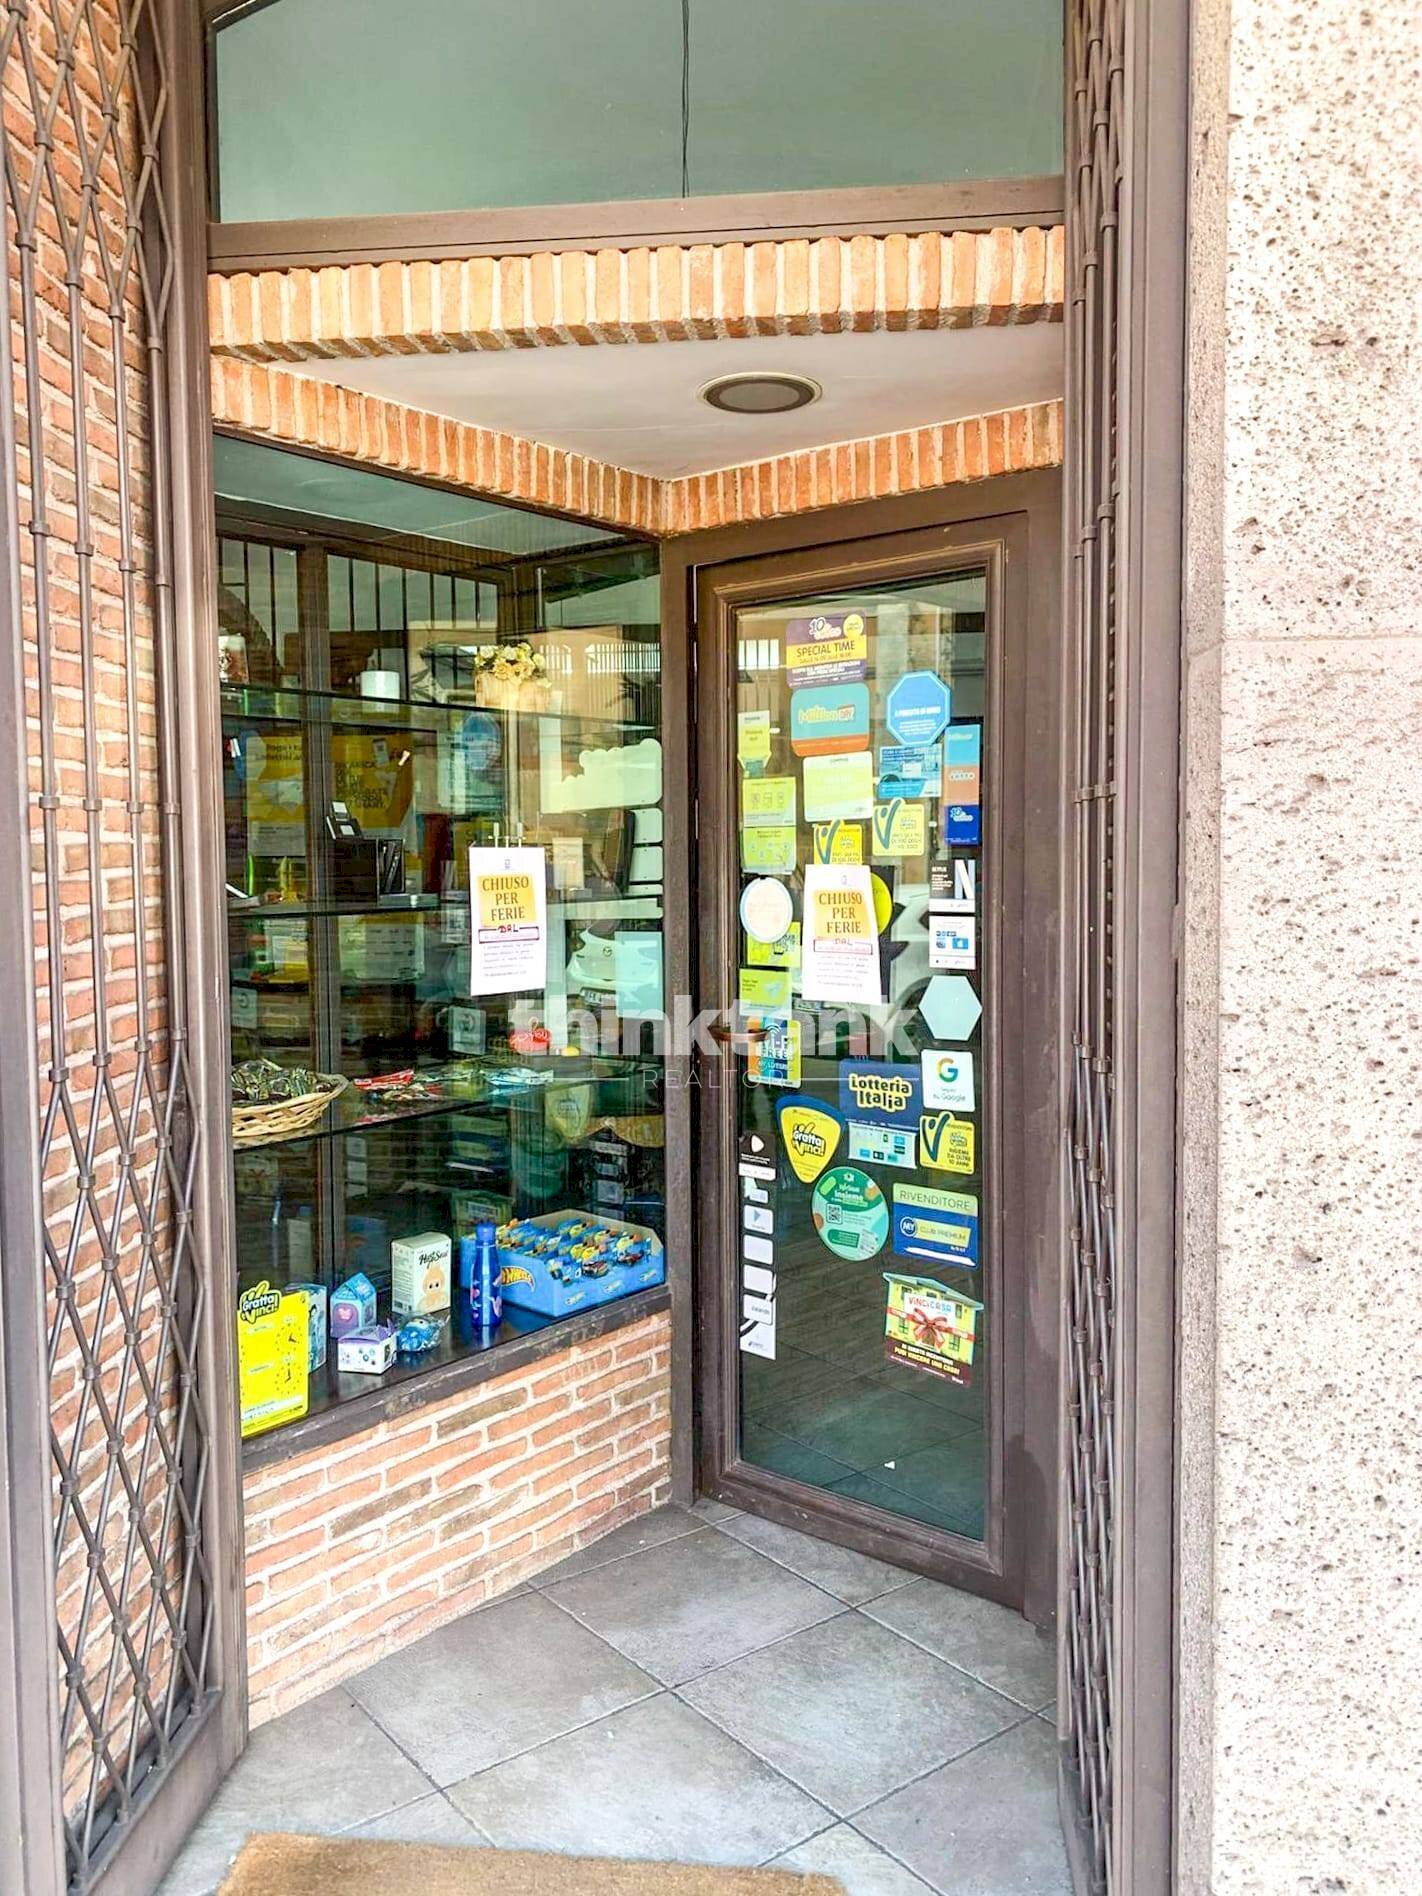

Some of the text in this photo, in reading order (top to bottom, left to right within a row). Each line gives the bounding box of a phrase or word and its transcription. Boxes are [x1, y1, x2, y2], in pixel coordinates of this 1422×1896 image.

[797, 642, 831, 658] SPECIAL
[834, 640, 855, 652] TIME
[482, 876, 529, 891] CHIUSO
[495, 892, 519, 905] PER
[819, 892, 862, 905] CHIUSO
[491, 906, 525, 921] FERIE
[832, 907, 856, 919] PER
[826, 921, 862, 934] FERIE
[852, 1076, 910, 1094] Lotteria
[860, 1091, 903, 1109] Italia
[899, 1190, 970, 1211] RIVENDITORE
[242, 1296, 274, 1312] Gratta
